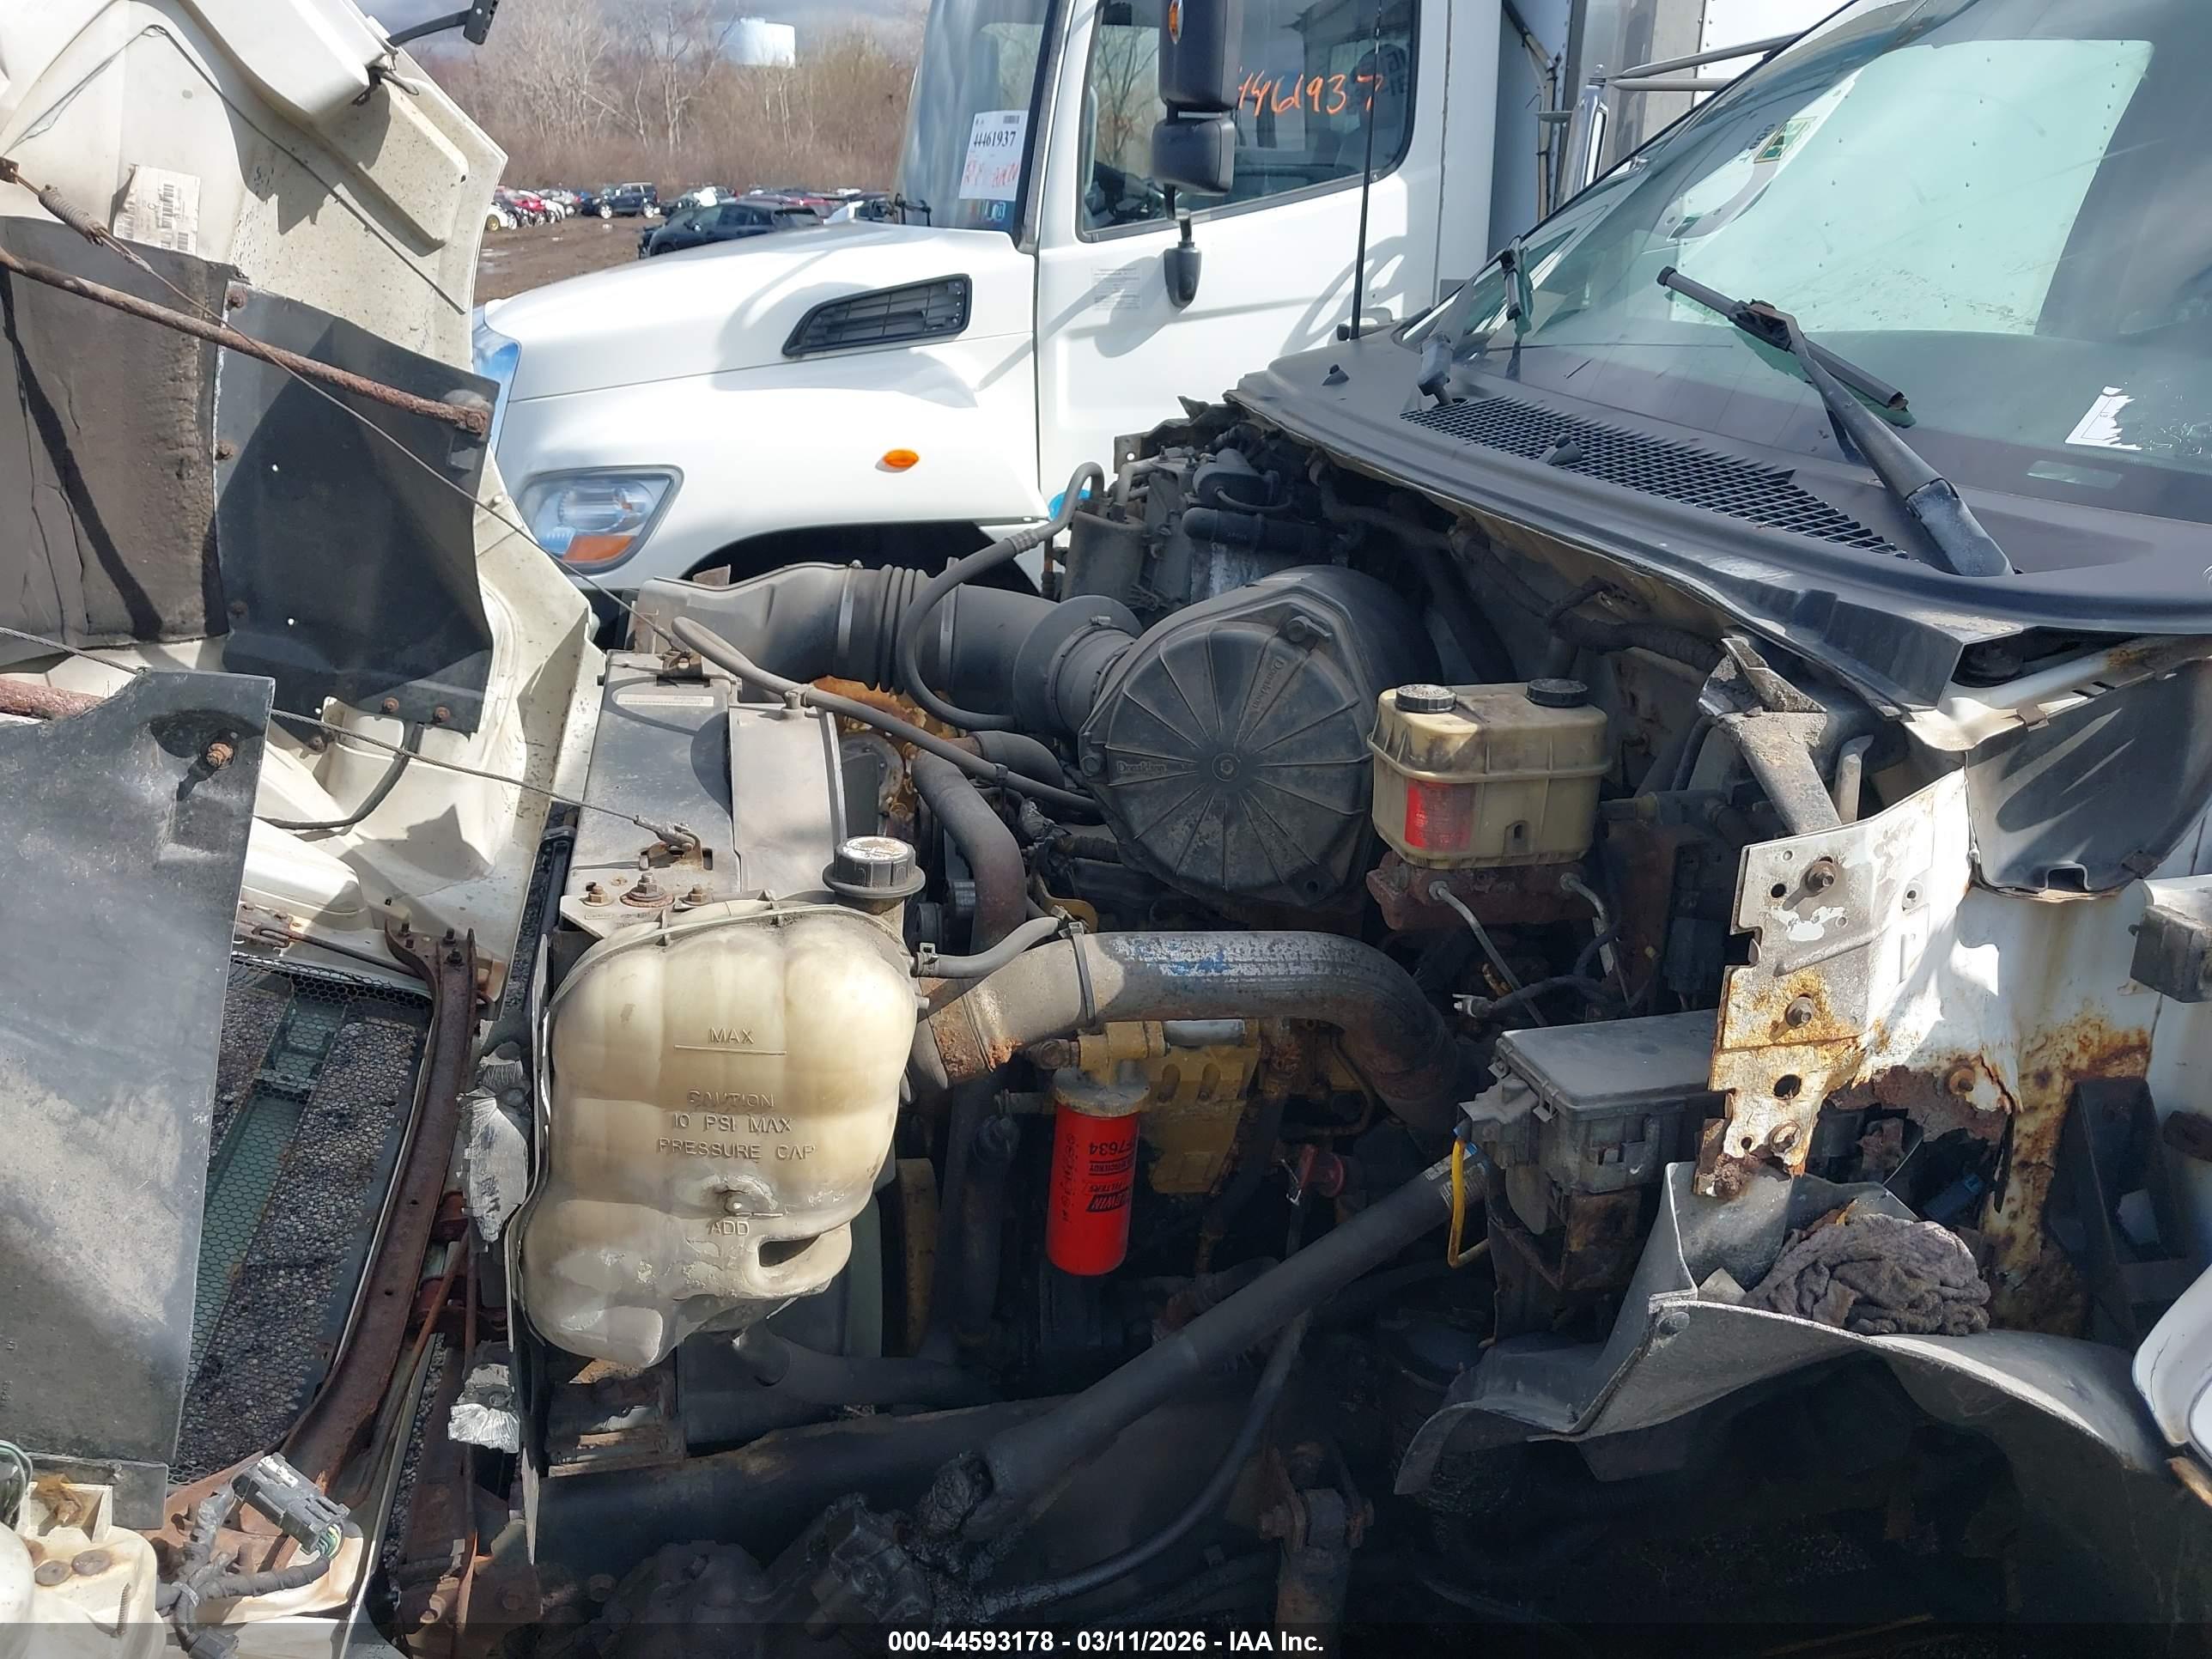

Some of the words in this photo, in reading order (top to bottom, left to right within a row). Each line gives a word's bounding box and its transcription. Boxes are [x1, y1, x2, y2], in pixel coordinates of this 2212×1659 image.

[974, 131, 1016, 148] 44461937
[708, 1028, 754, 1044] MAX
[687, 1090, 775, 1108] CAUTION
[672, 1113, 691, 1127] 10
[703, 1115, 736, 1131] PSI
[748, 1116, 792, 1133] MAX
[659, 1138, 762, 1159] PRESSURE
[776, 1144, 815, 1160] CAP
[708, 1220, 749, 1235] ADD
